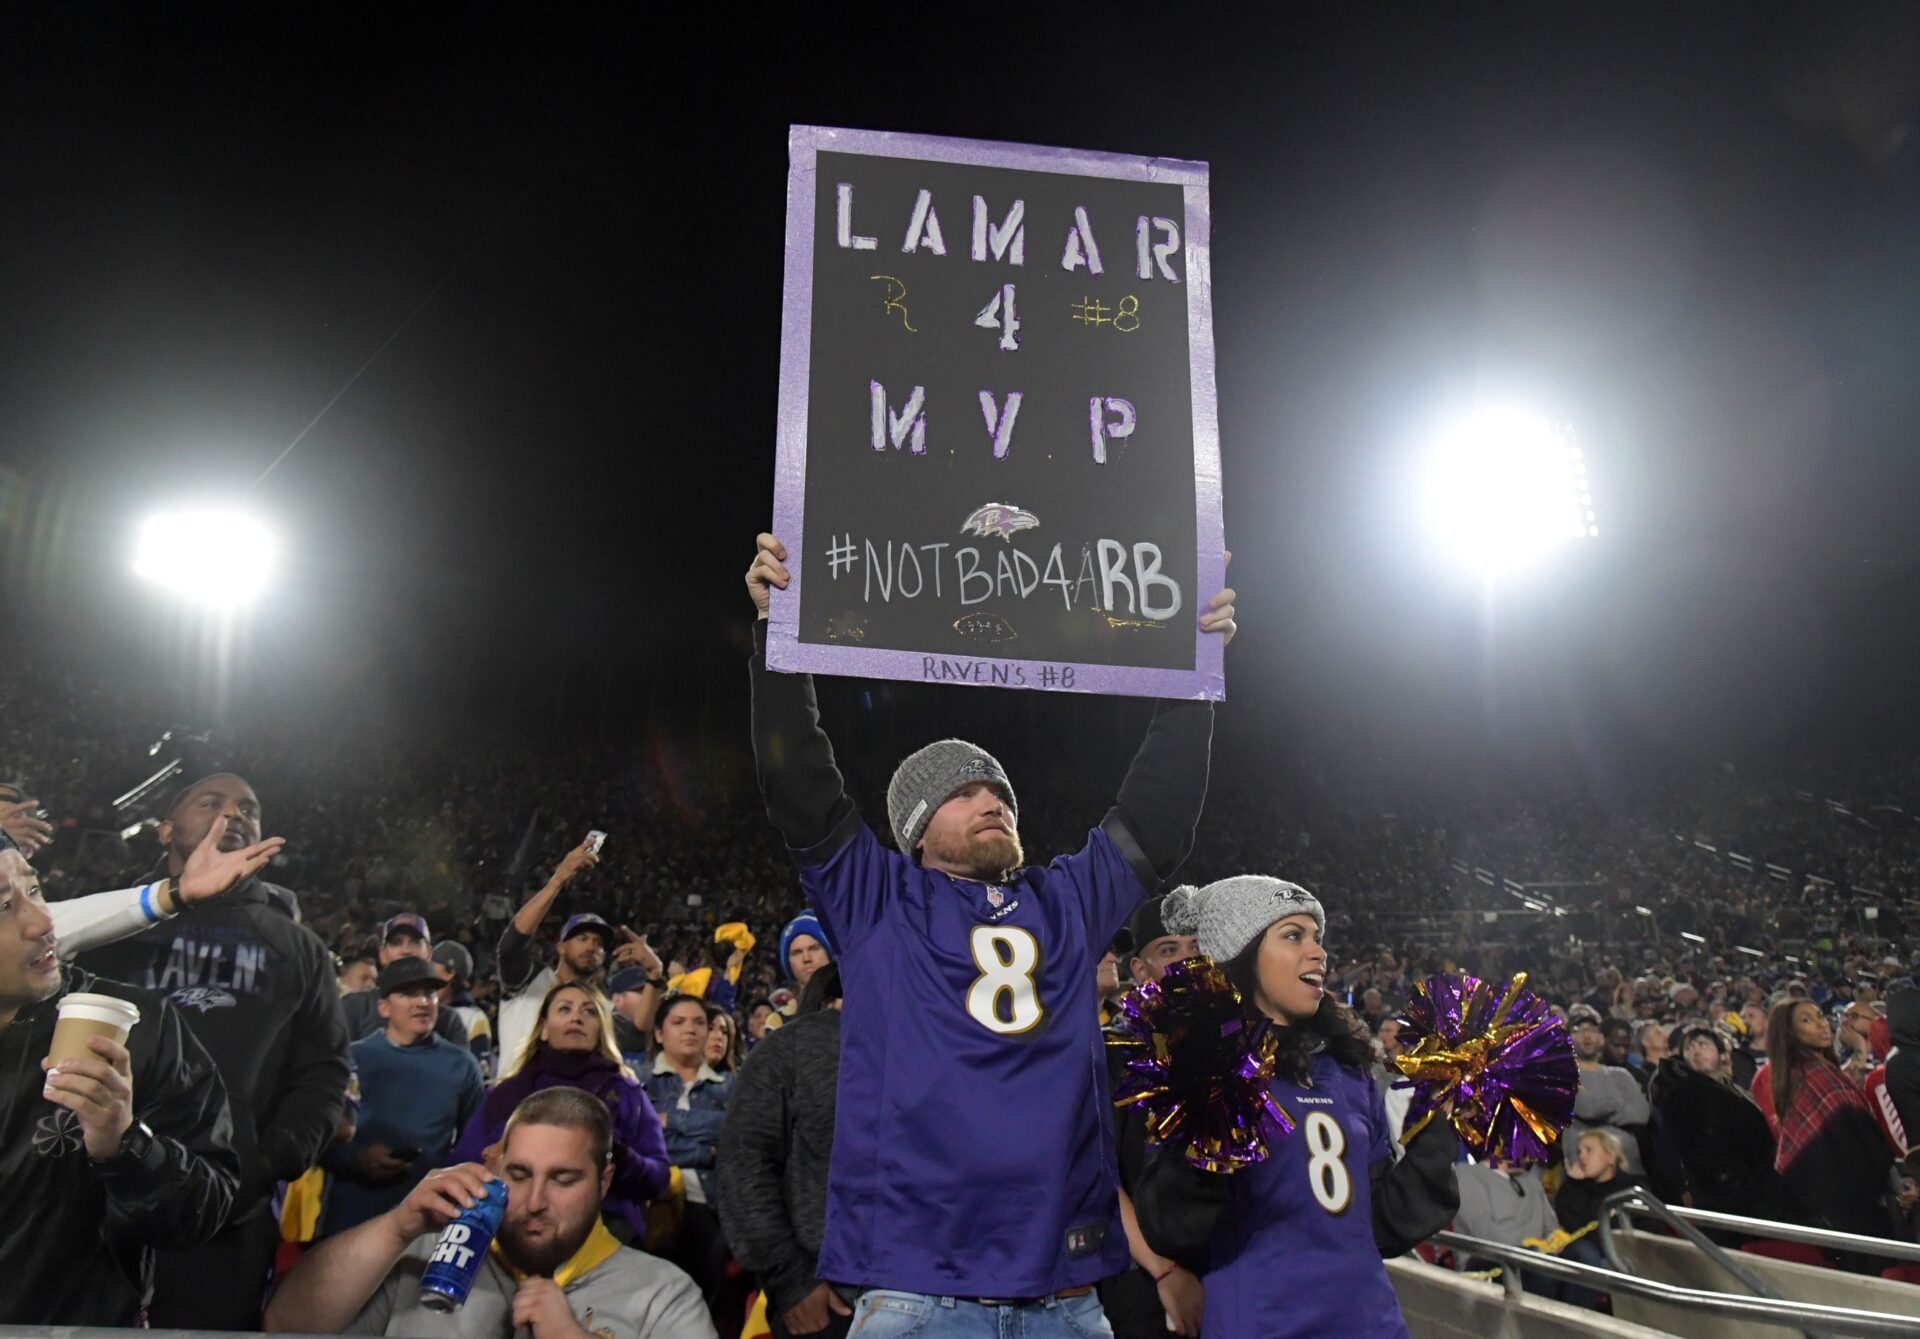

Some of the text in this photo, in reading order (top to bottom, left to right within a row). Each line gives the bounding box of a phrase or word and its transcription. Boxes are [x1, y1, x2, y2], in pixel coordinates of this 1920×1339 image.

[836, 182, 1182, 283] LAMAR
[974, 284, 1021, 351] 4
[1071, 295, 1140, 332] #8
[869, 379, 1137, 464] MVP
[825, 532, 1182, 620] #NOTBAD4ARB
[922, 655, 1076, 689] RAVEN'S #8
[966, 924, 1044, 1035] 8
[1296, 1096, 1334, 1105] RAVENS
[1305, 1111, 1351, 1214] 8
